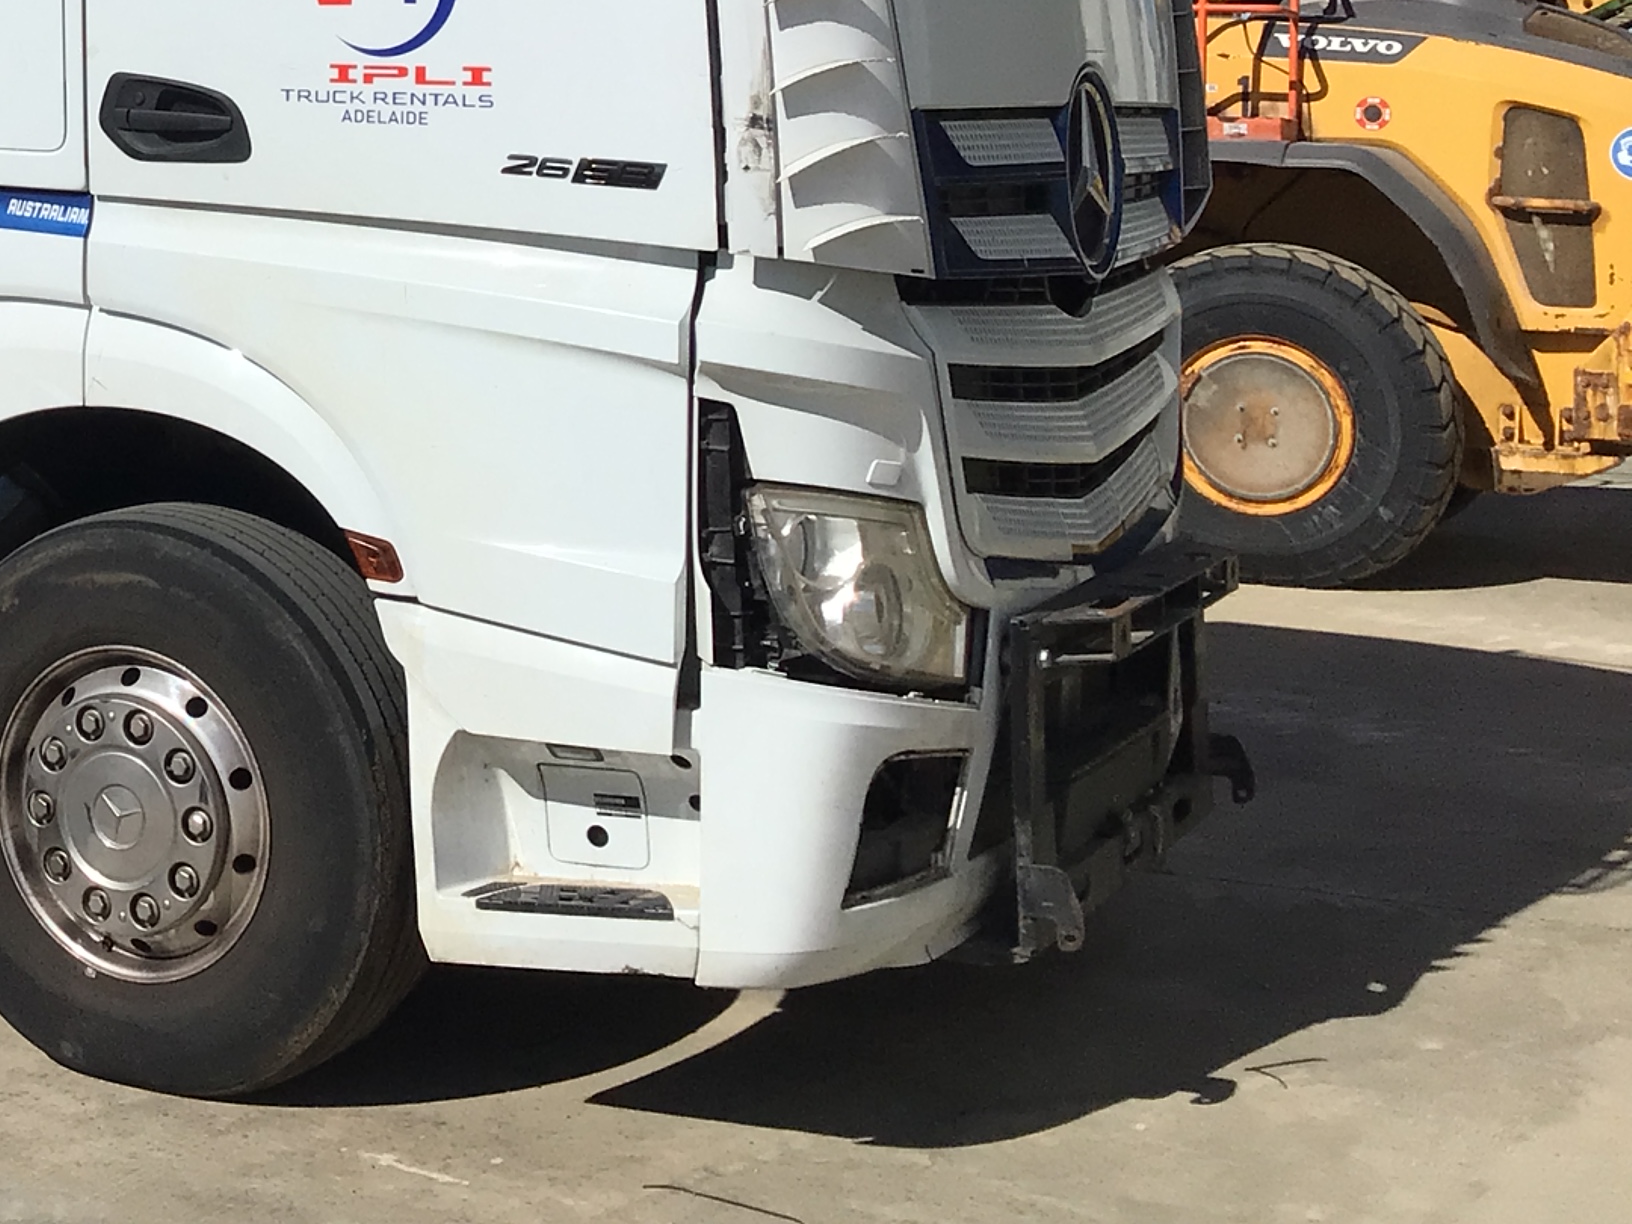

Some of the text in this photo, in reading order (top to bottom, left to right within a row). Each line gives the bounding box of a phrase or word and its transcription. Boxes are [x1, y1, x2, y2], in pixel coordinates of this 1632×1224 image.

[1274, 33, 1403, 55] VOLVO
[329, 64, 492, 87] IPLI
[280, 88, 494, 108] TRUCK RENTALS
[341, 109, 429, 125] ADELAIDE
